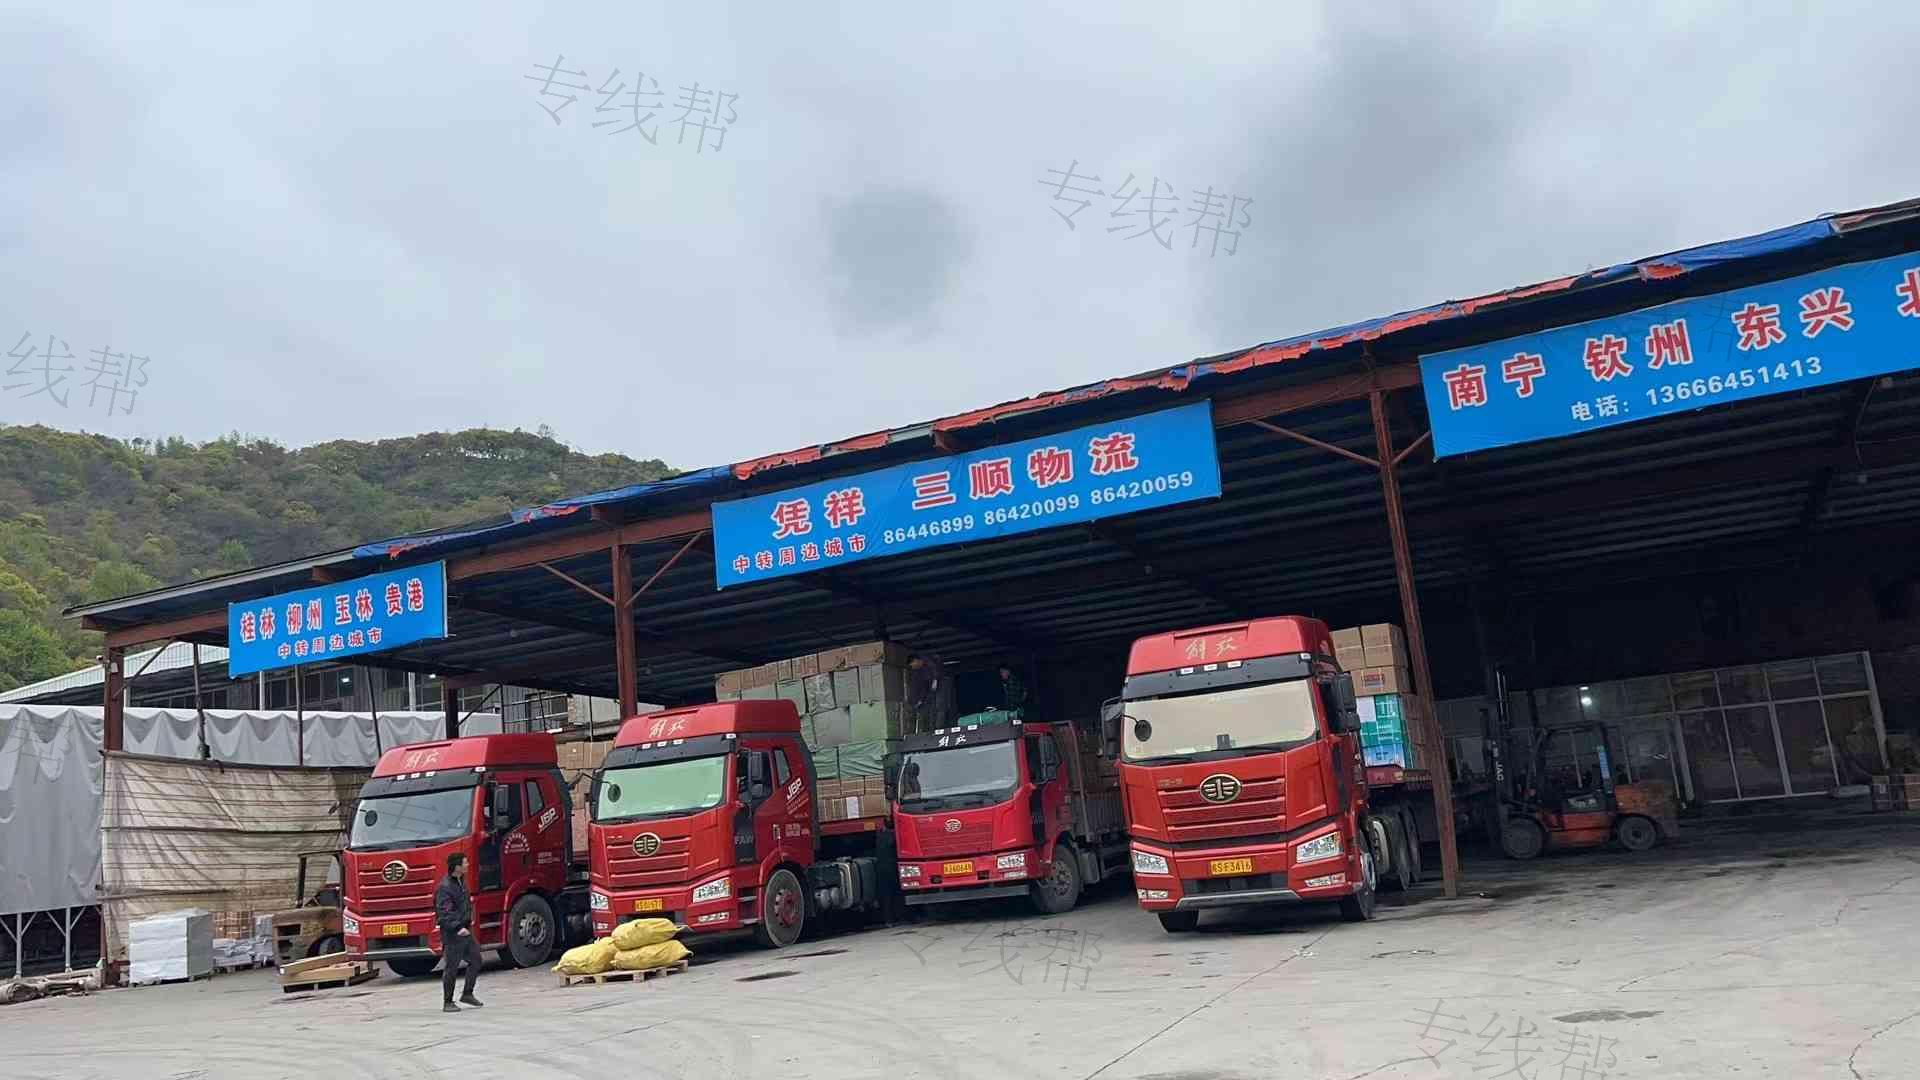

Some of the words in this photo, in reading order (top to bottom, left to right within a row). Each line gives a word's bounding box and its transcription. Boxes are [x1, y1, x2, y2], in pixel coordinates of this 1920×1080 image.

[1443, 352, 1546, 410] 南宁
[1583, 320, 1694, 382] 钦州
[1731, 286, 1854, 351] 东兴
[1571, 398, 1631, 422] 电话：
[1645, 355, 1823, 407] 13666451413
[733, 533, 867, 575] 中转周边城市
[883, 514, 975, 546] 86446899
[984, 494, 1080, 525] 86420099
[1090, 471, 1194, 505] 86420059
[771, 486, 866, 540] 凭祥
[911, 431, 1139, 511] 三顺物流
[240, 607, 276, 643] 桂林
[286, 598, 323, 636] 柳州
[335, 588, 374, 625] 玉林
[385, 577, 424, 616] 贵港
[277, 627, 383, 659] 中转周边城市
